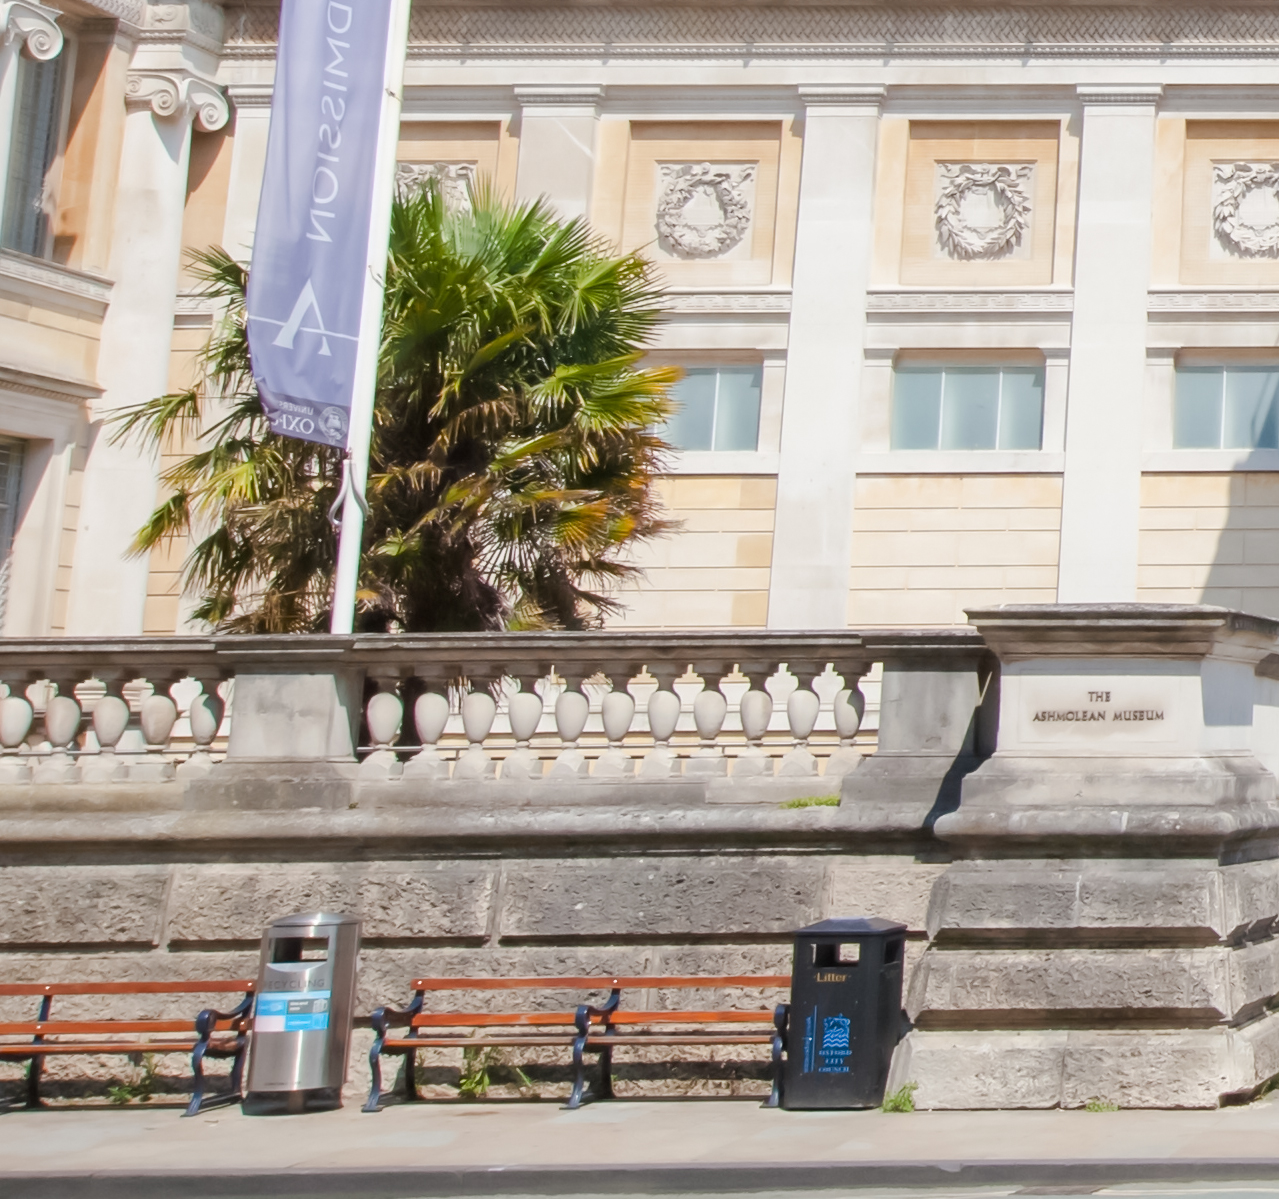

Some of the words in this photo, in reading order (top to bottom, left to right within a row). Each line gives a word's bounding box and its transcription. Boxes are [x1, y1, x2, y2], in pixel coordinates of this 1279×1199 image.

[1088, 691, 1111, 702] THE
[1032, 710, 1106, 722] ASHMOLEAN
[1112, 710, 1165, 721] MUSEUM
[816, 972, 848, 982] Litter
[264, 978, 325, 990] ECYCLING
